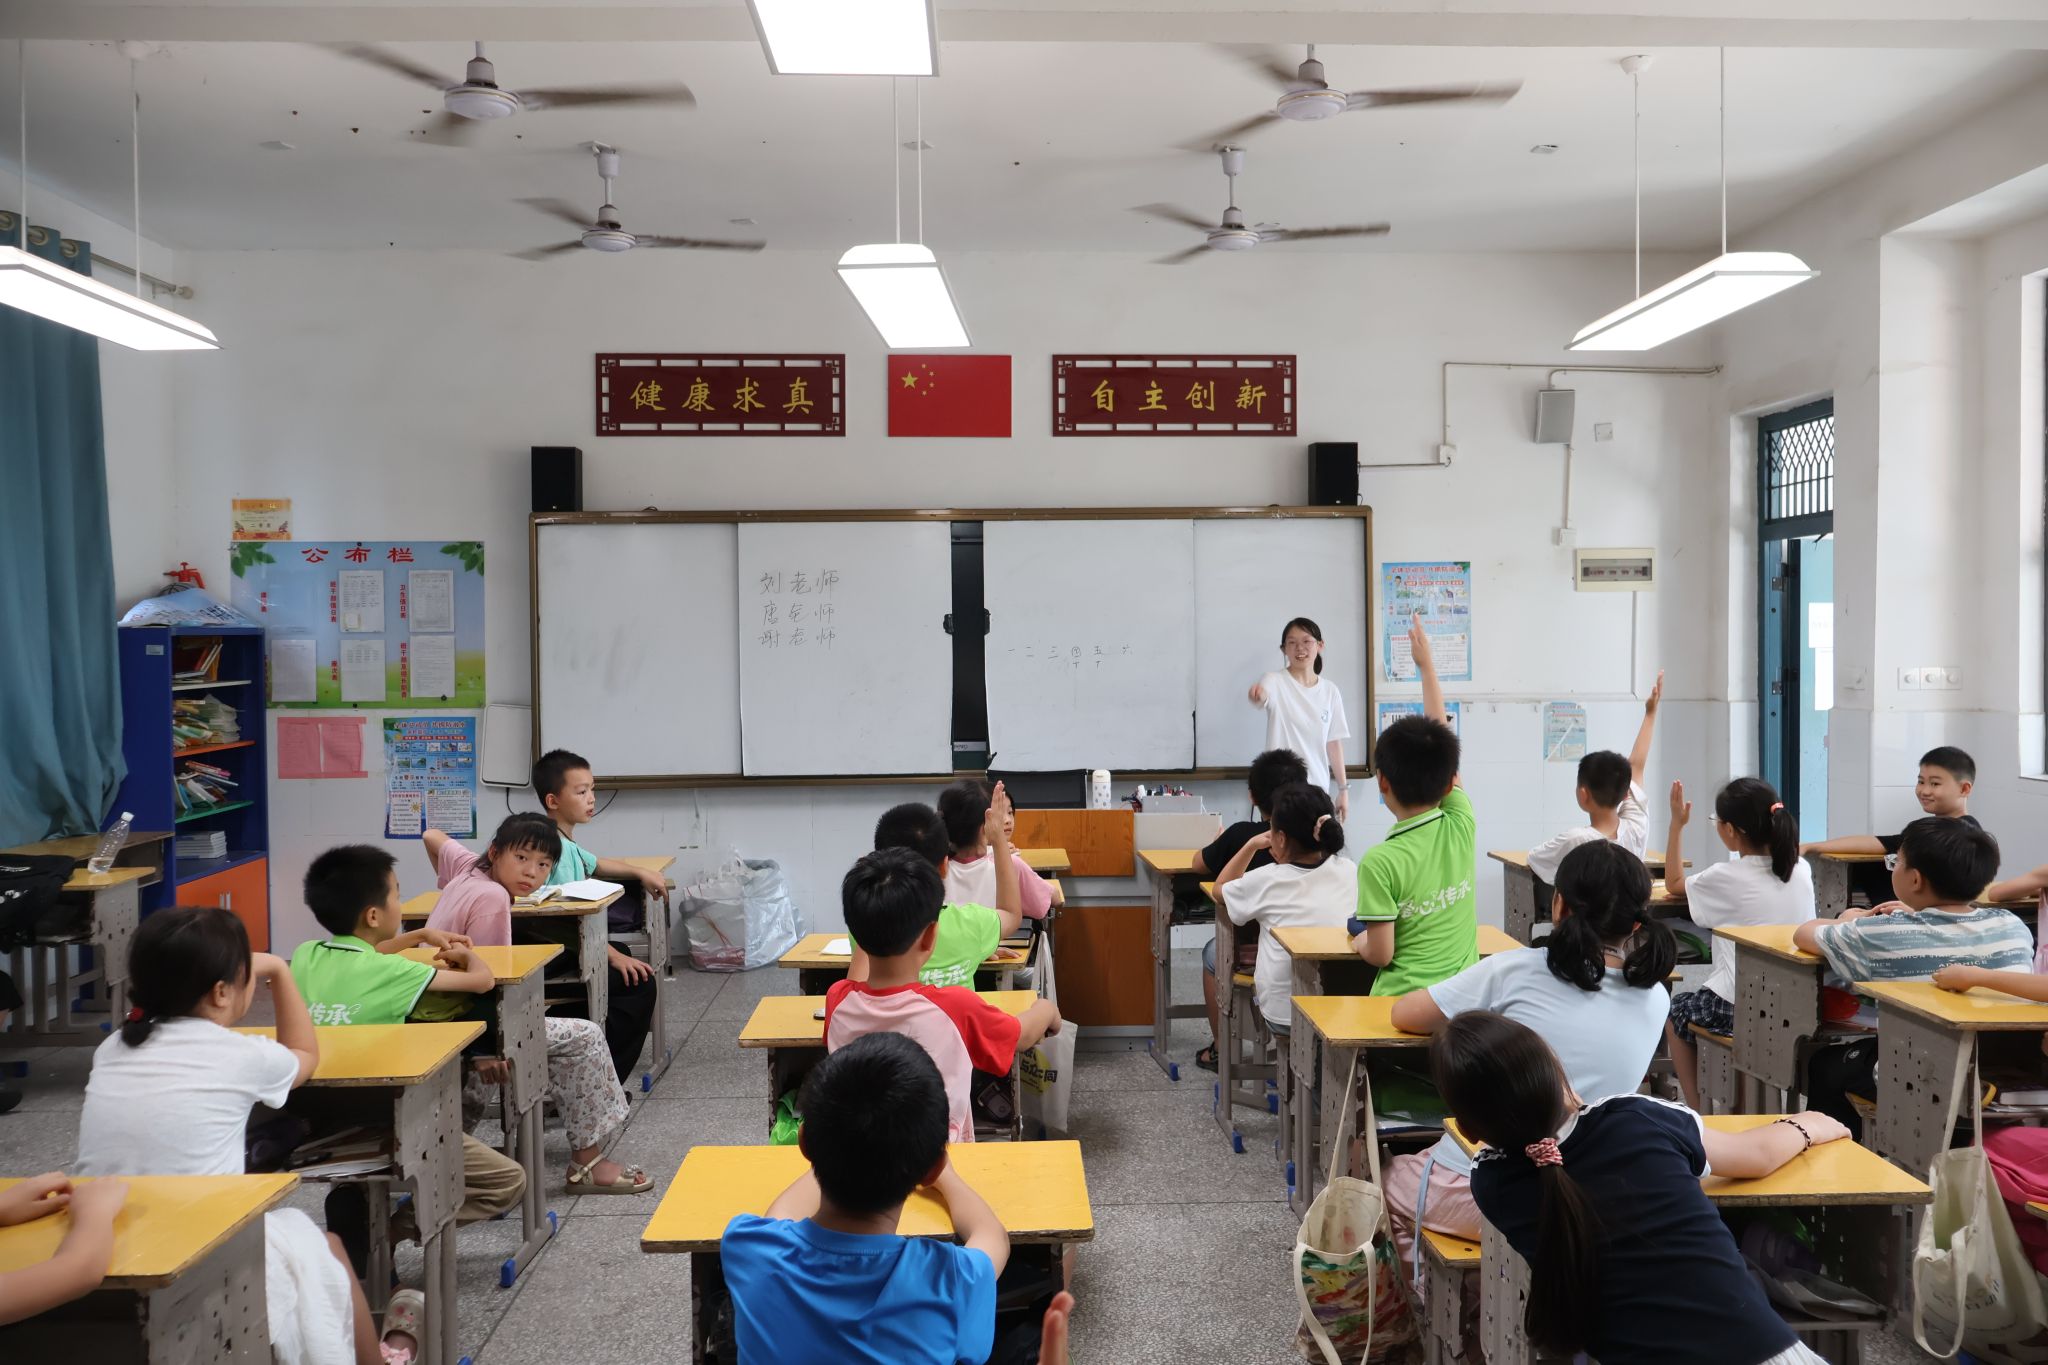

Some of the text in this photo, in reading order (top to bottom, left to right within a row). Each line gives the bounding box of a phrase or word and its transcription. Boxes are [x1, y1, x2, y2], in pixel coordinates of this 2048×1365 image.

[629, 376, 815, 415] 健康求真
[1090, 378, 1268, 414] 自主创新
[301, 546, 415, 564] 公布栏
[759, 569, 840, 600] 刘老师
[307, 1001, 353, 1026] 传承
